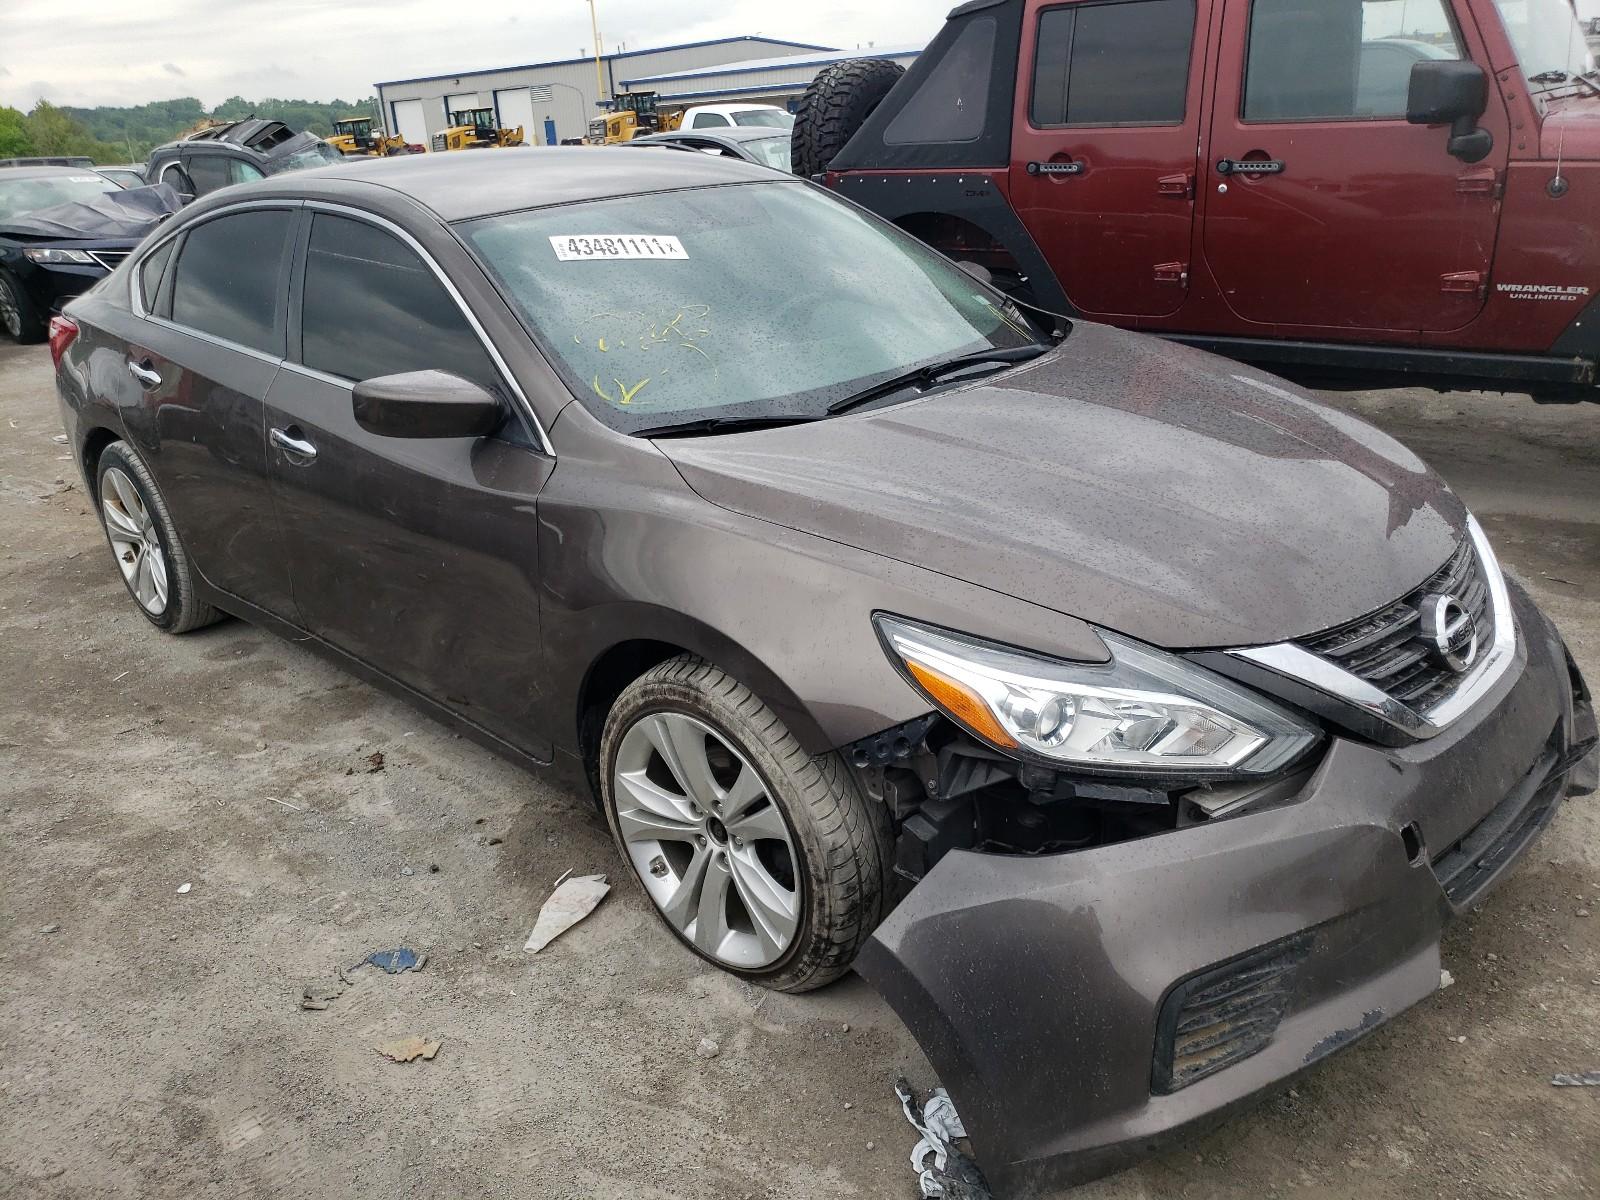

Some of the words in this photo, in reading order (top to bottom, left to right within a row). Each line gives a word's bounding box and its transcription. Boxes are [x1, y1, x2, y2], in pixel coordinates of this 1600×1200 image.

[568, 238, 666, 255] 43481111
[1496, 283, 1589, 295] WRANGLER
[1509, 293, 1577, 301] UNLIMITED
